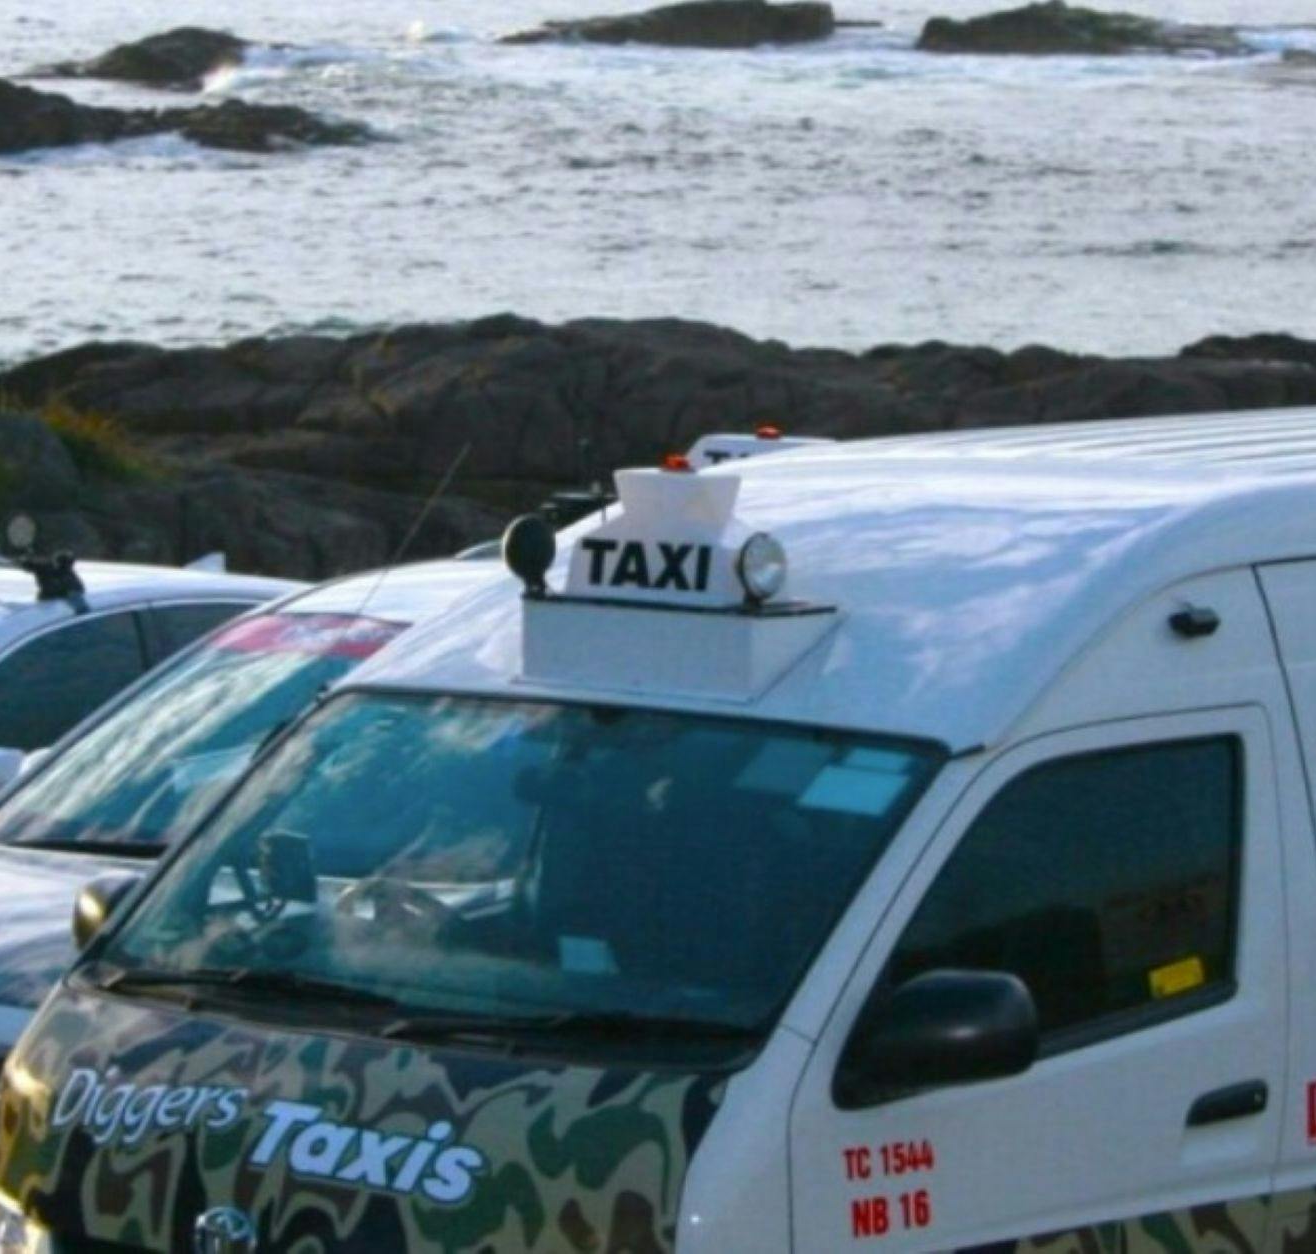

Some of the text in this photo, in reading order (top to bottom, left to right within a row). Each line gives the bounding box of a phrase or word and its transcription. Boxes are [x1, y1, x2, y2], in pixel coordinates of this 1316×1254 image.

[582, 538, 712, 590] TAXI
[53, 1067, 485, 1203] Diggers Taxis
[843, 1139, 935, 1181] TC 1544
[850, 1189, 932, 1239] NB 16
